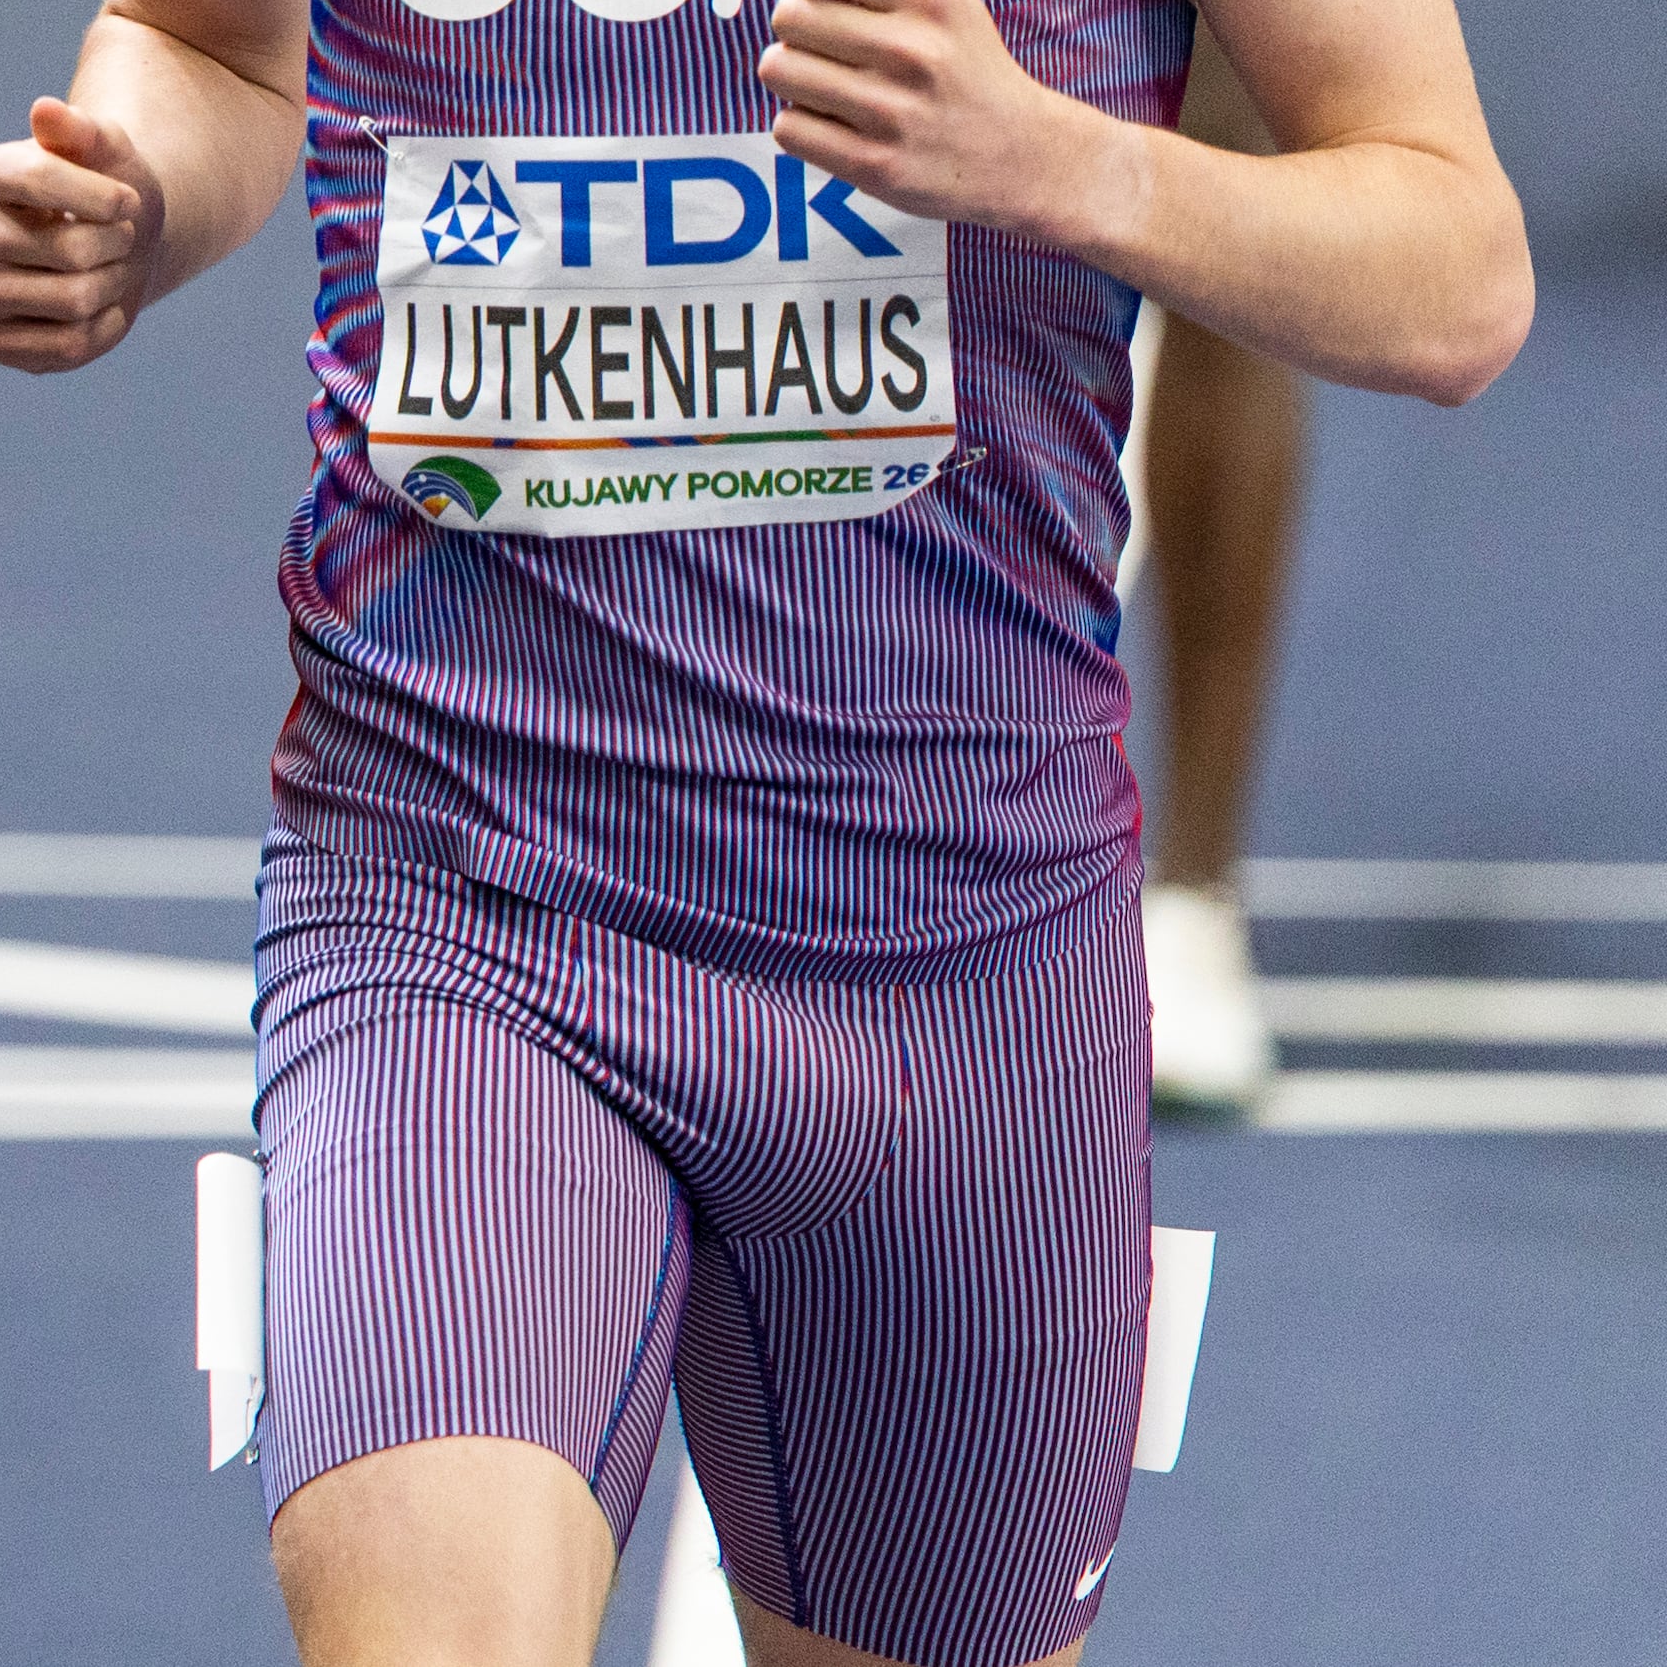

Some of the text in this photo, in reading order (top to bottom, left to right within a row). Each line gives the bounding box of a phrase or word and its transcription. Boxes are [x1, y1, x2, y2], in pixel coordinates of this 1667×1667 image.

[515, 154, 904, 267] TDK
[397, 294, 928, 421] LUTKENHAUS
[525, 462, 930, 508] KUJAWY POMORZE 26
